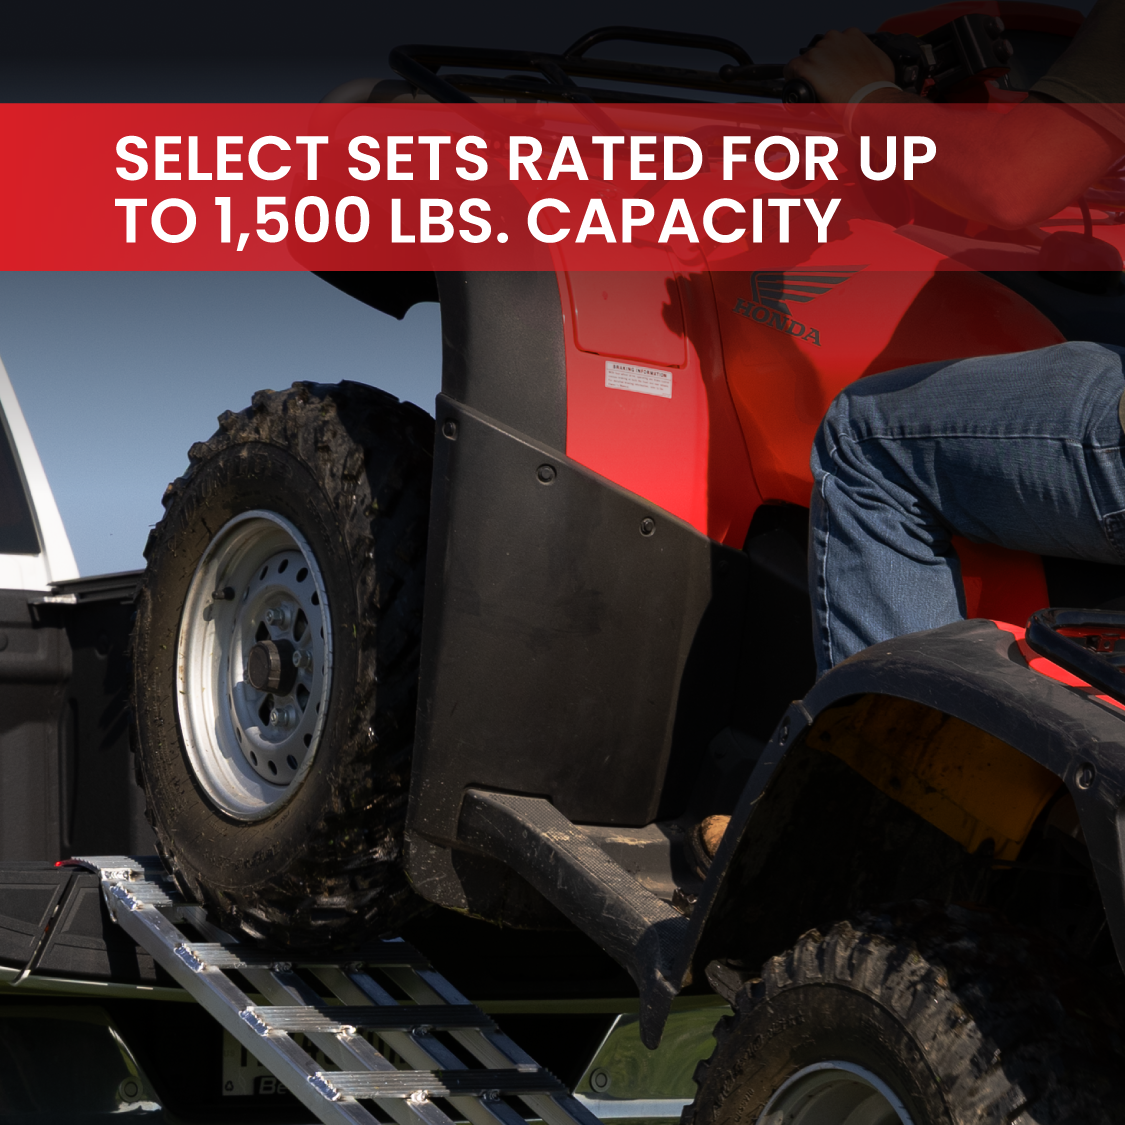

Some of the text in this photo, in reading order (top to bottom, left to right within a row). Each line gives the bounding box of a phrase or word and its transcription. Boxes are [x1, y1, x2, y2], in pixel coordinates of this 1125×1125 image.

[732, 298, 822, 347] HONDA
[613, 364, 667, 377] BRAKING INFORMATION
